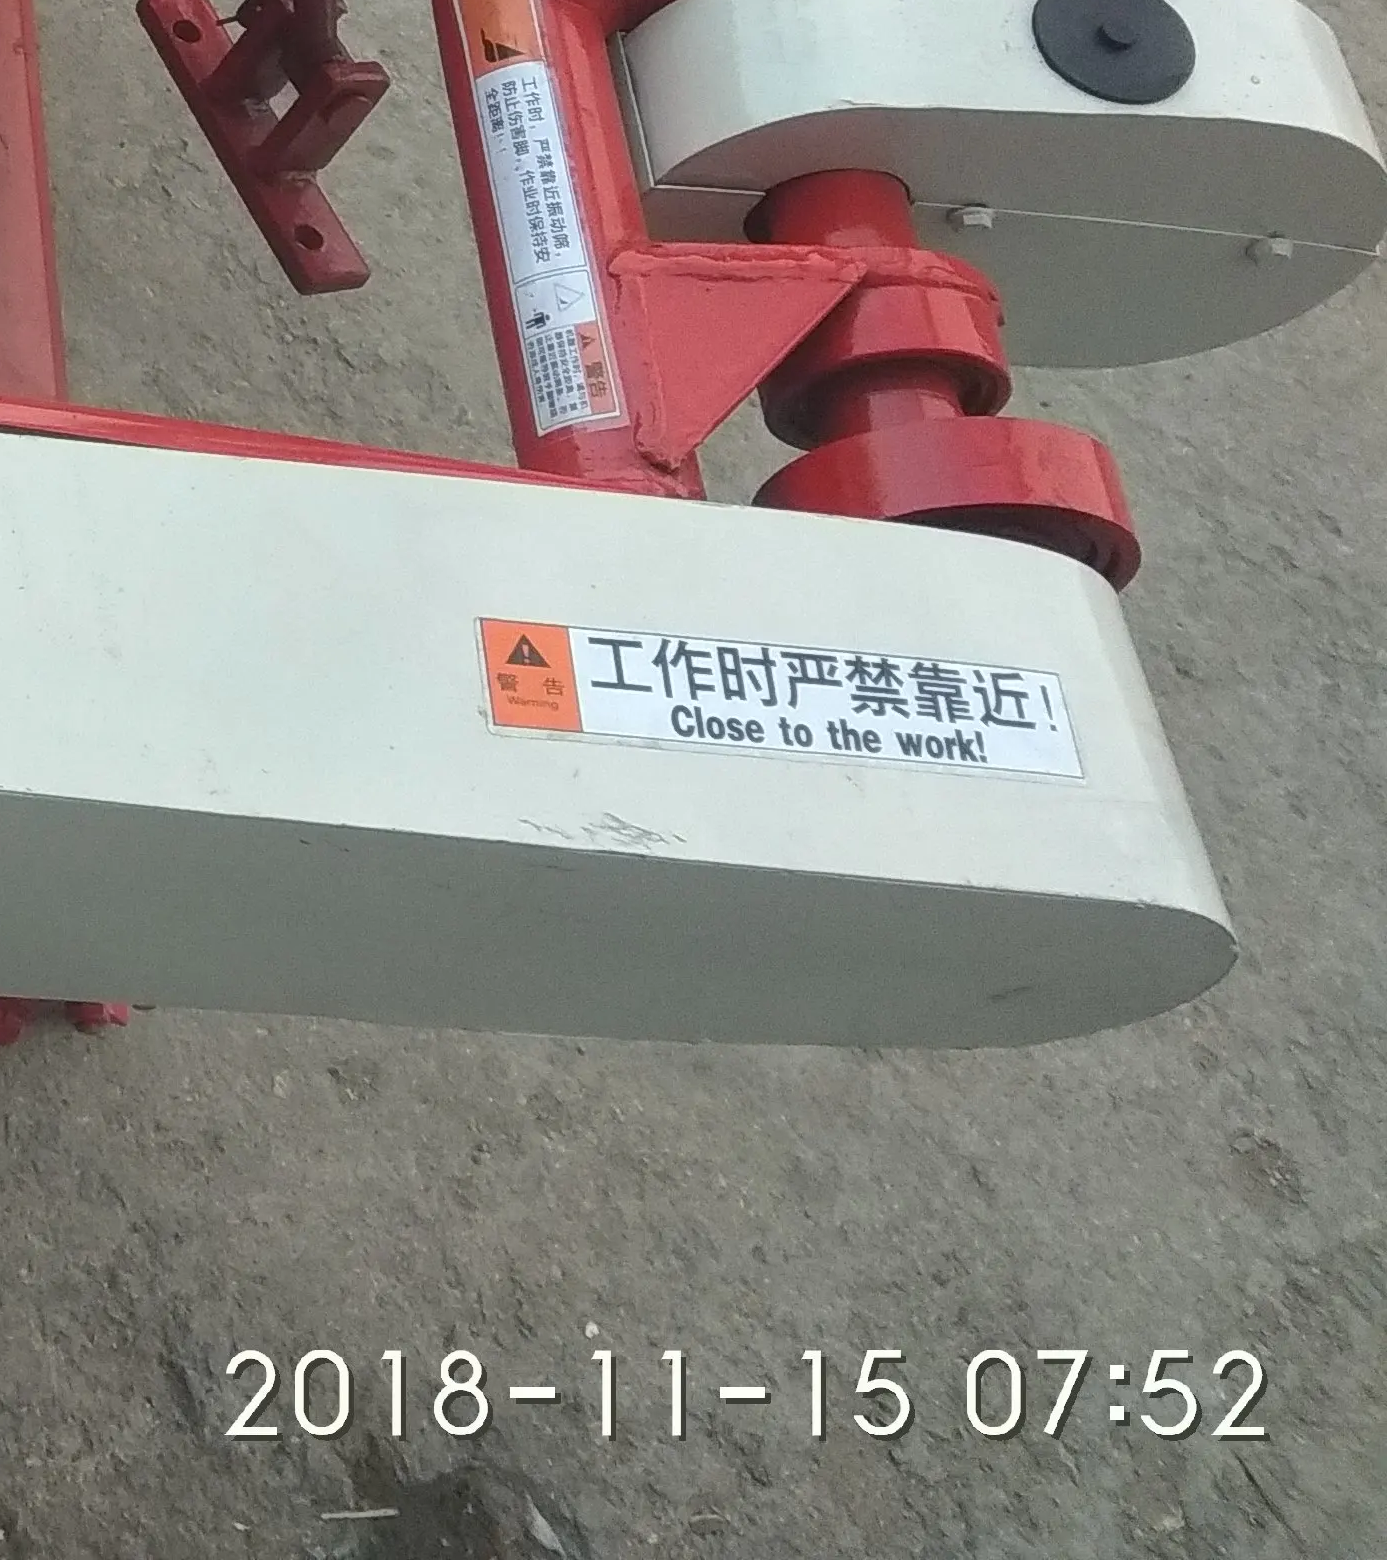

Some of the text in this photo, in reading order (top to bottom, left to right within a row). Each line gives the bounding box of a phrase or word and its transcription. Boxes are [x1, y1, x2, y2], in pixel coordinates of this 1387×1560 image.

[496, 672, 565, 697] 警告
[507, 695, 559, 711] Warning
[671, 704, 988, 763] Close to the work!
